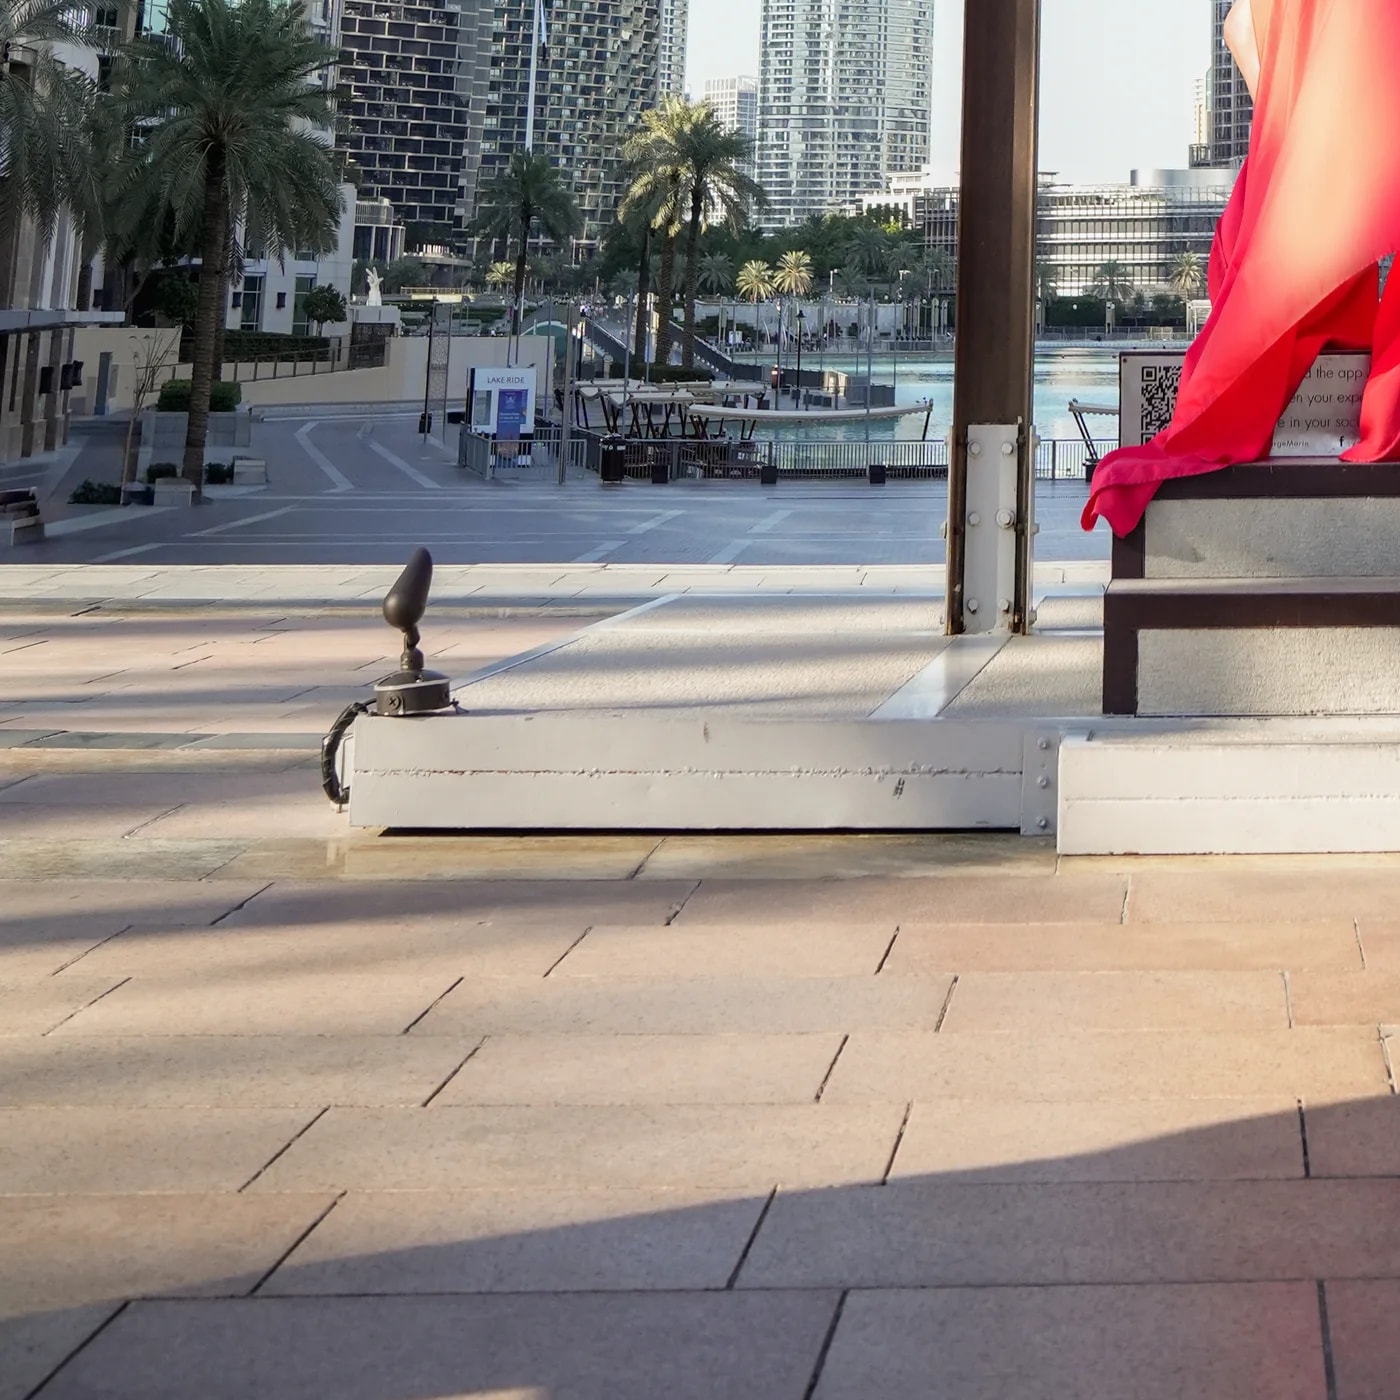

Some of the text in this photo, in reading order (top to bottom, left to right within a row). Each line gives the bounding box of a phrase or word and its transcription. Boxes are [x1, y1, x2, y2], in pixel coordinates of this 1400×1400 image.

[487, 376, 525, 384] LAKE RIDE
[1316, 365, 1333, 379] the
[1337, 368, 1363, 382] app
[1307, 393, 1333, 407] your
[1336, 393, 1362, 404] exp
[1290, 416, 1300, 428] in
[1304, 418, 1330, 431] your
[1273, 440, 1309, 449] rgeMarin
